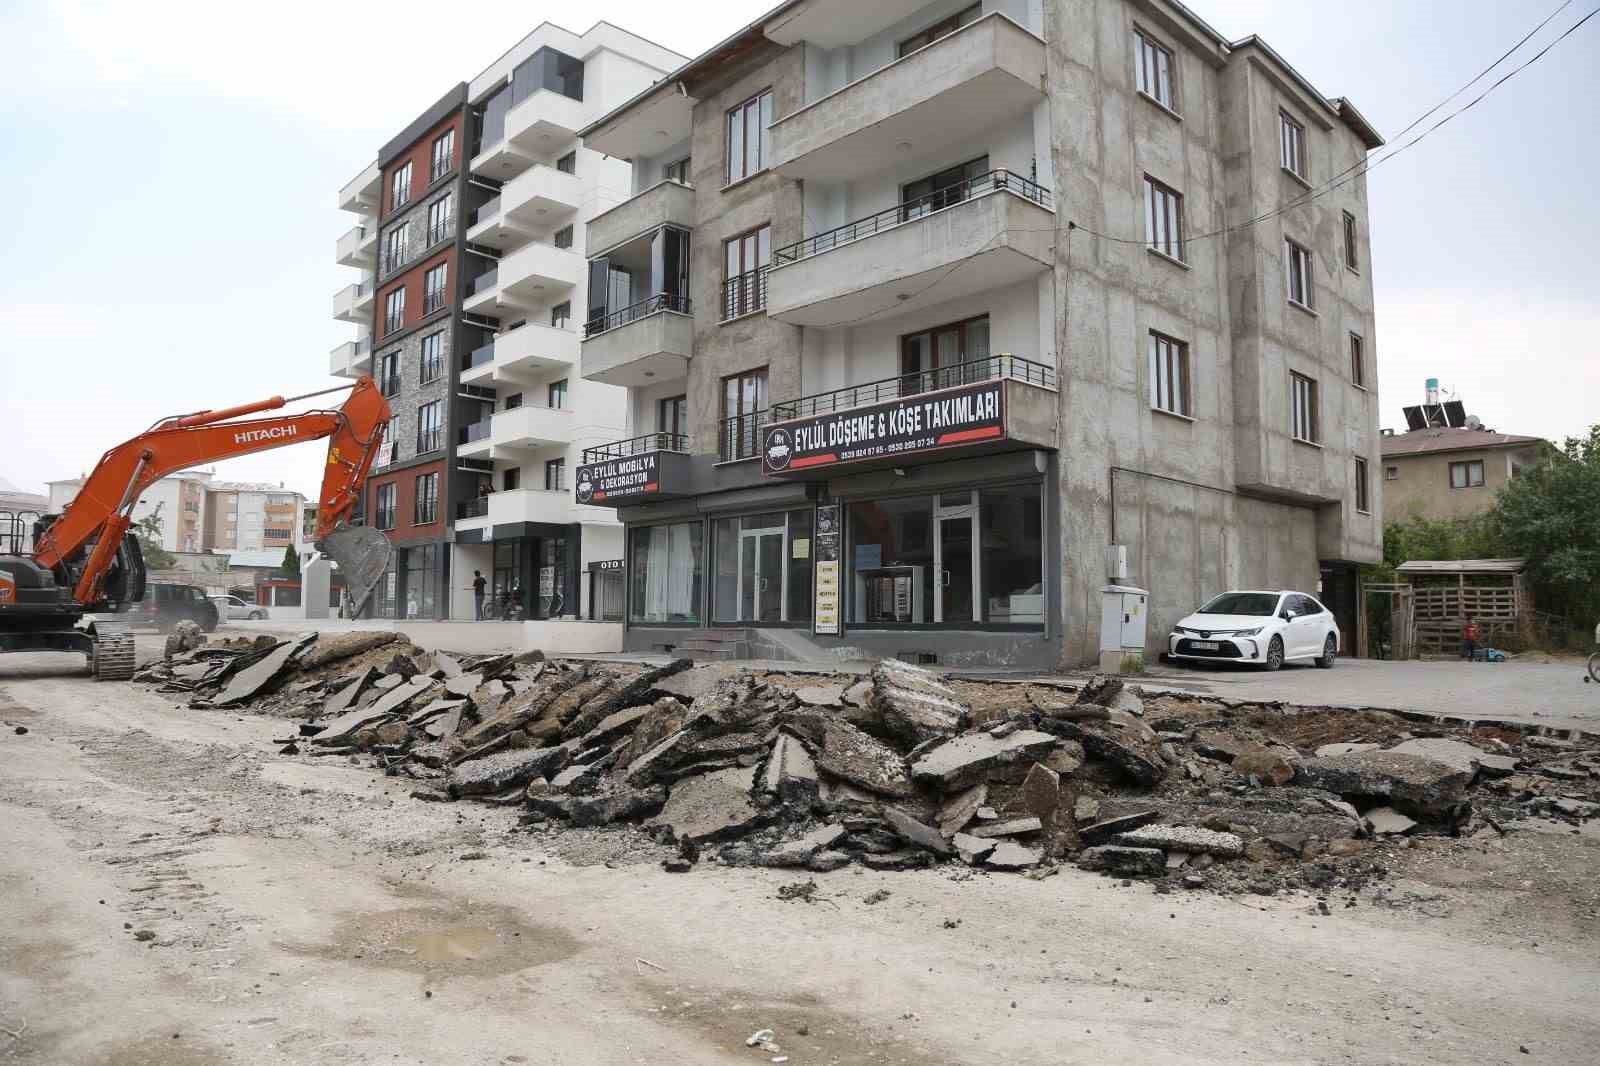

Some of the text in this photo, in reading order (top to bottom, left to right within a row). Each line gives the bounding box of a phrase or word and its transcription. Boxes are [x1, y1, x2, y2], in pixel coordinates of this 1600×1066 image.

[795, 390, 999, 452] EYLÜL DÖŞEME & KÖŞE TAKIMLARI
[234, 425, 297, 444] HITACHI
[618, 456, 655, 475] MOBİLYA
[605, 471, 648, 489] DEKORASYON
[601, 561, 619, 569] OTO
